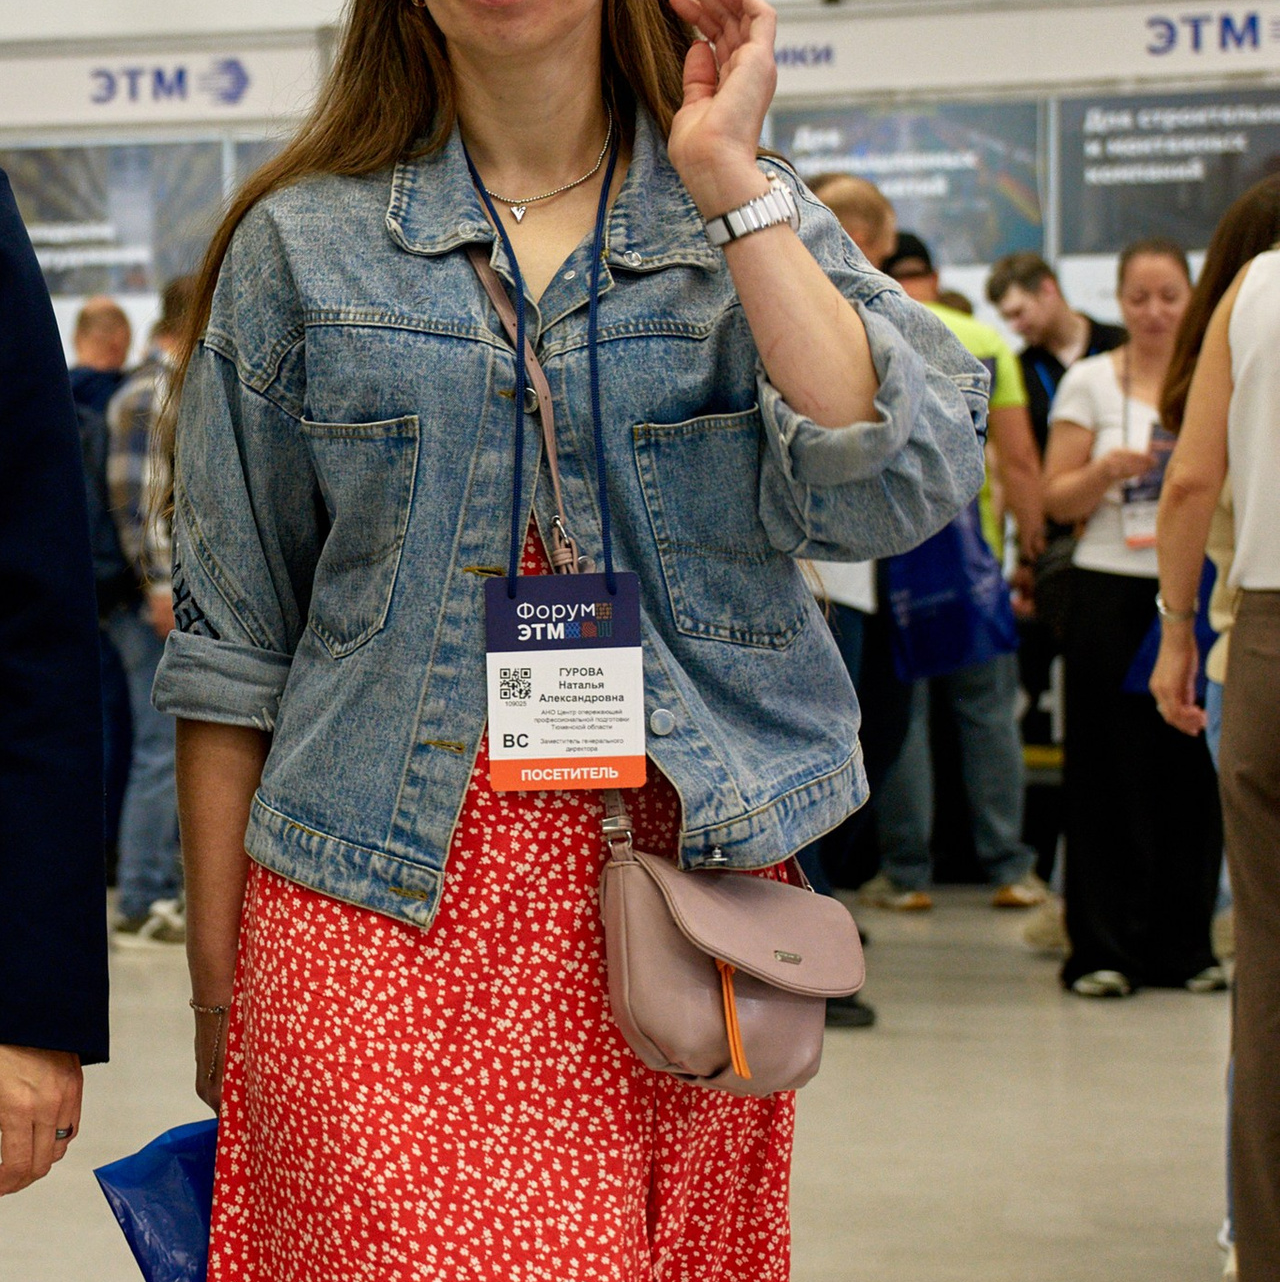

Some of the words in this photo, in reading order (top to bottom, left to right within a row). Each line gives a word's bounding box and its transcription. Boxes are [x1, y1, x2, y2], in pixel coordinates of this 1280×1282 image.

[1145, 12, 1261, 56] ЭТМ
[90, 66, 188, 105] ЭТМ
[516, 601, 596, 623] Форум
[517, 622, 565, 641] ЭТМ
[559, 667, 604, 677] ГУРОВА
[558, 680, 605, 690] Наталья
[539, 693, 625, 704] Александровна
[520, 766, 619, 782] ПОСЕТИТЕЛЬ
